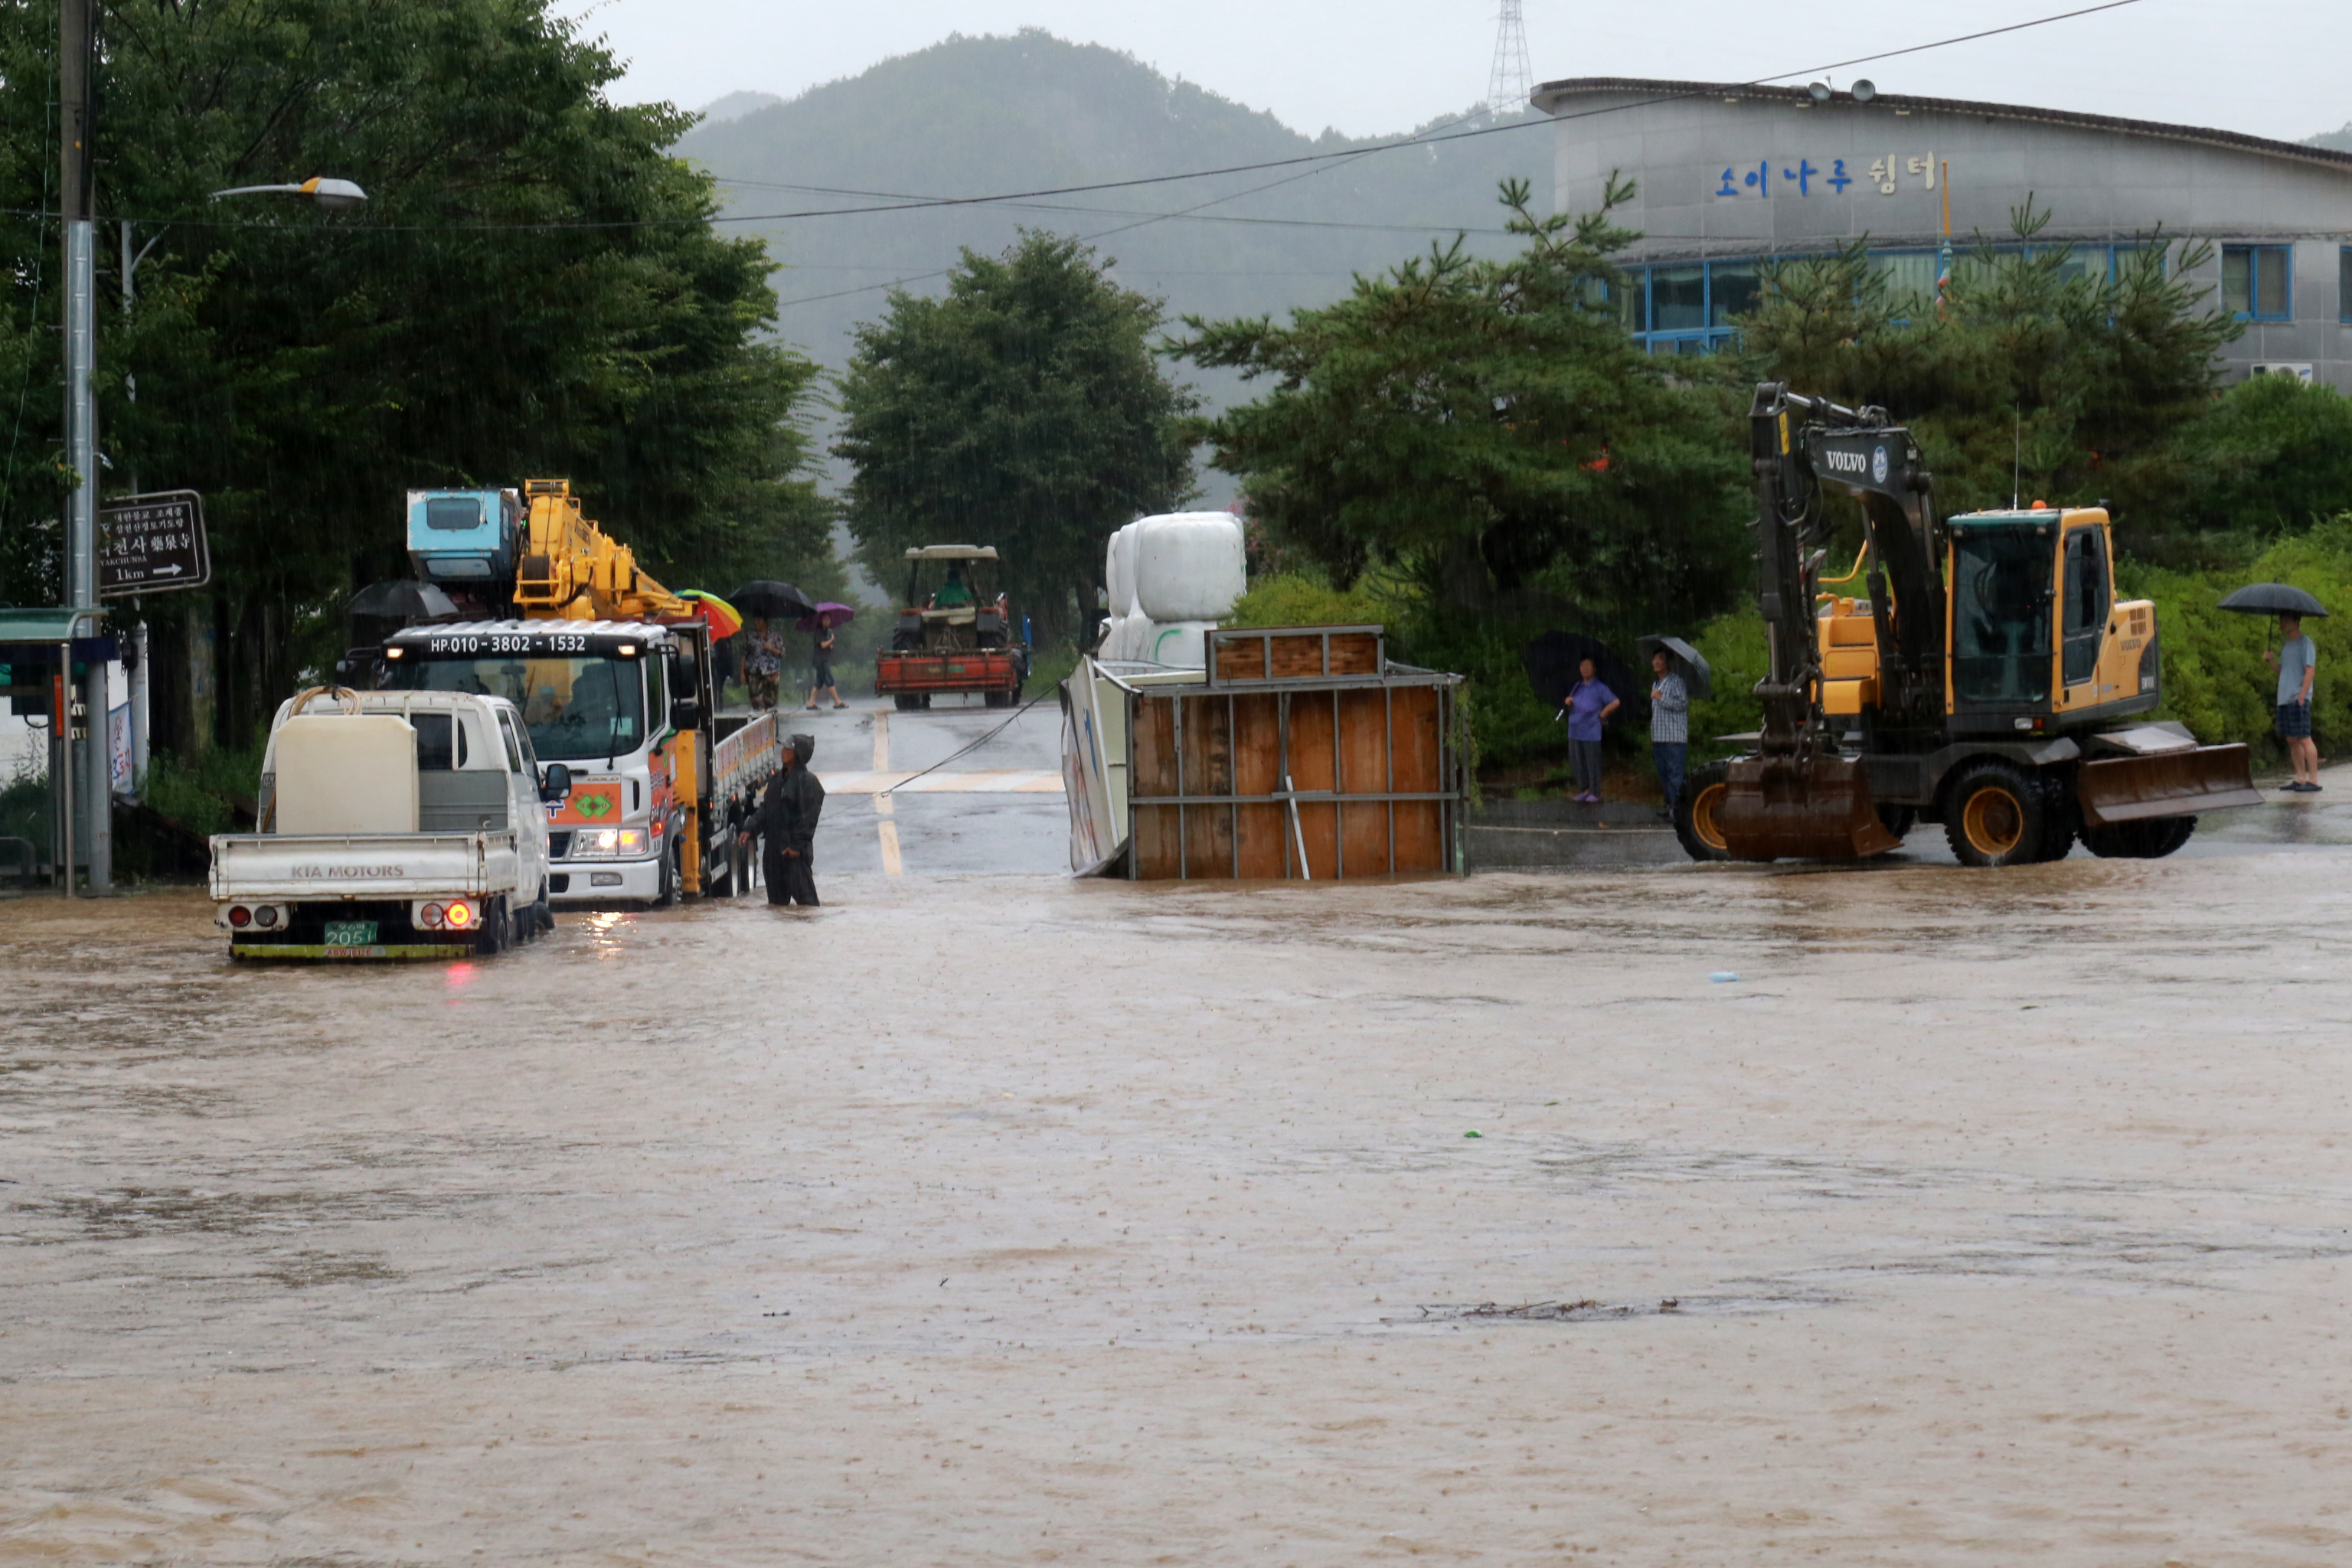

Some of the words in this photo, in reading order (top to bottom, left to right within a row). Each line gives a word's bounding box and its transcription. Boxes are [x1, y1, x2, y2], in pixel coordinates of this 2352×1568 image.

[1716, 158, 1853, 198] 소이나루
[1868, 151, 1935, 195] 쉼터
[1826, 450, 1866, 473] VOLVO
[116, 568, 145, 581] 1km
[431, 637, 478, 652] HP.010
[492, 636, 530, 651] 3802
[549, 635, 585, 651] 1532
[2120, 638, 2141, 651] VOLVO
[292, 866, 322, 878] KIA
[328, 864, 404, 877] MOTORS
